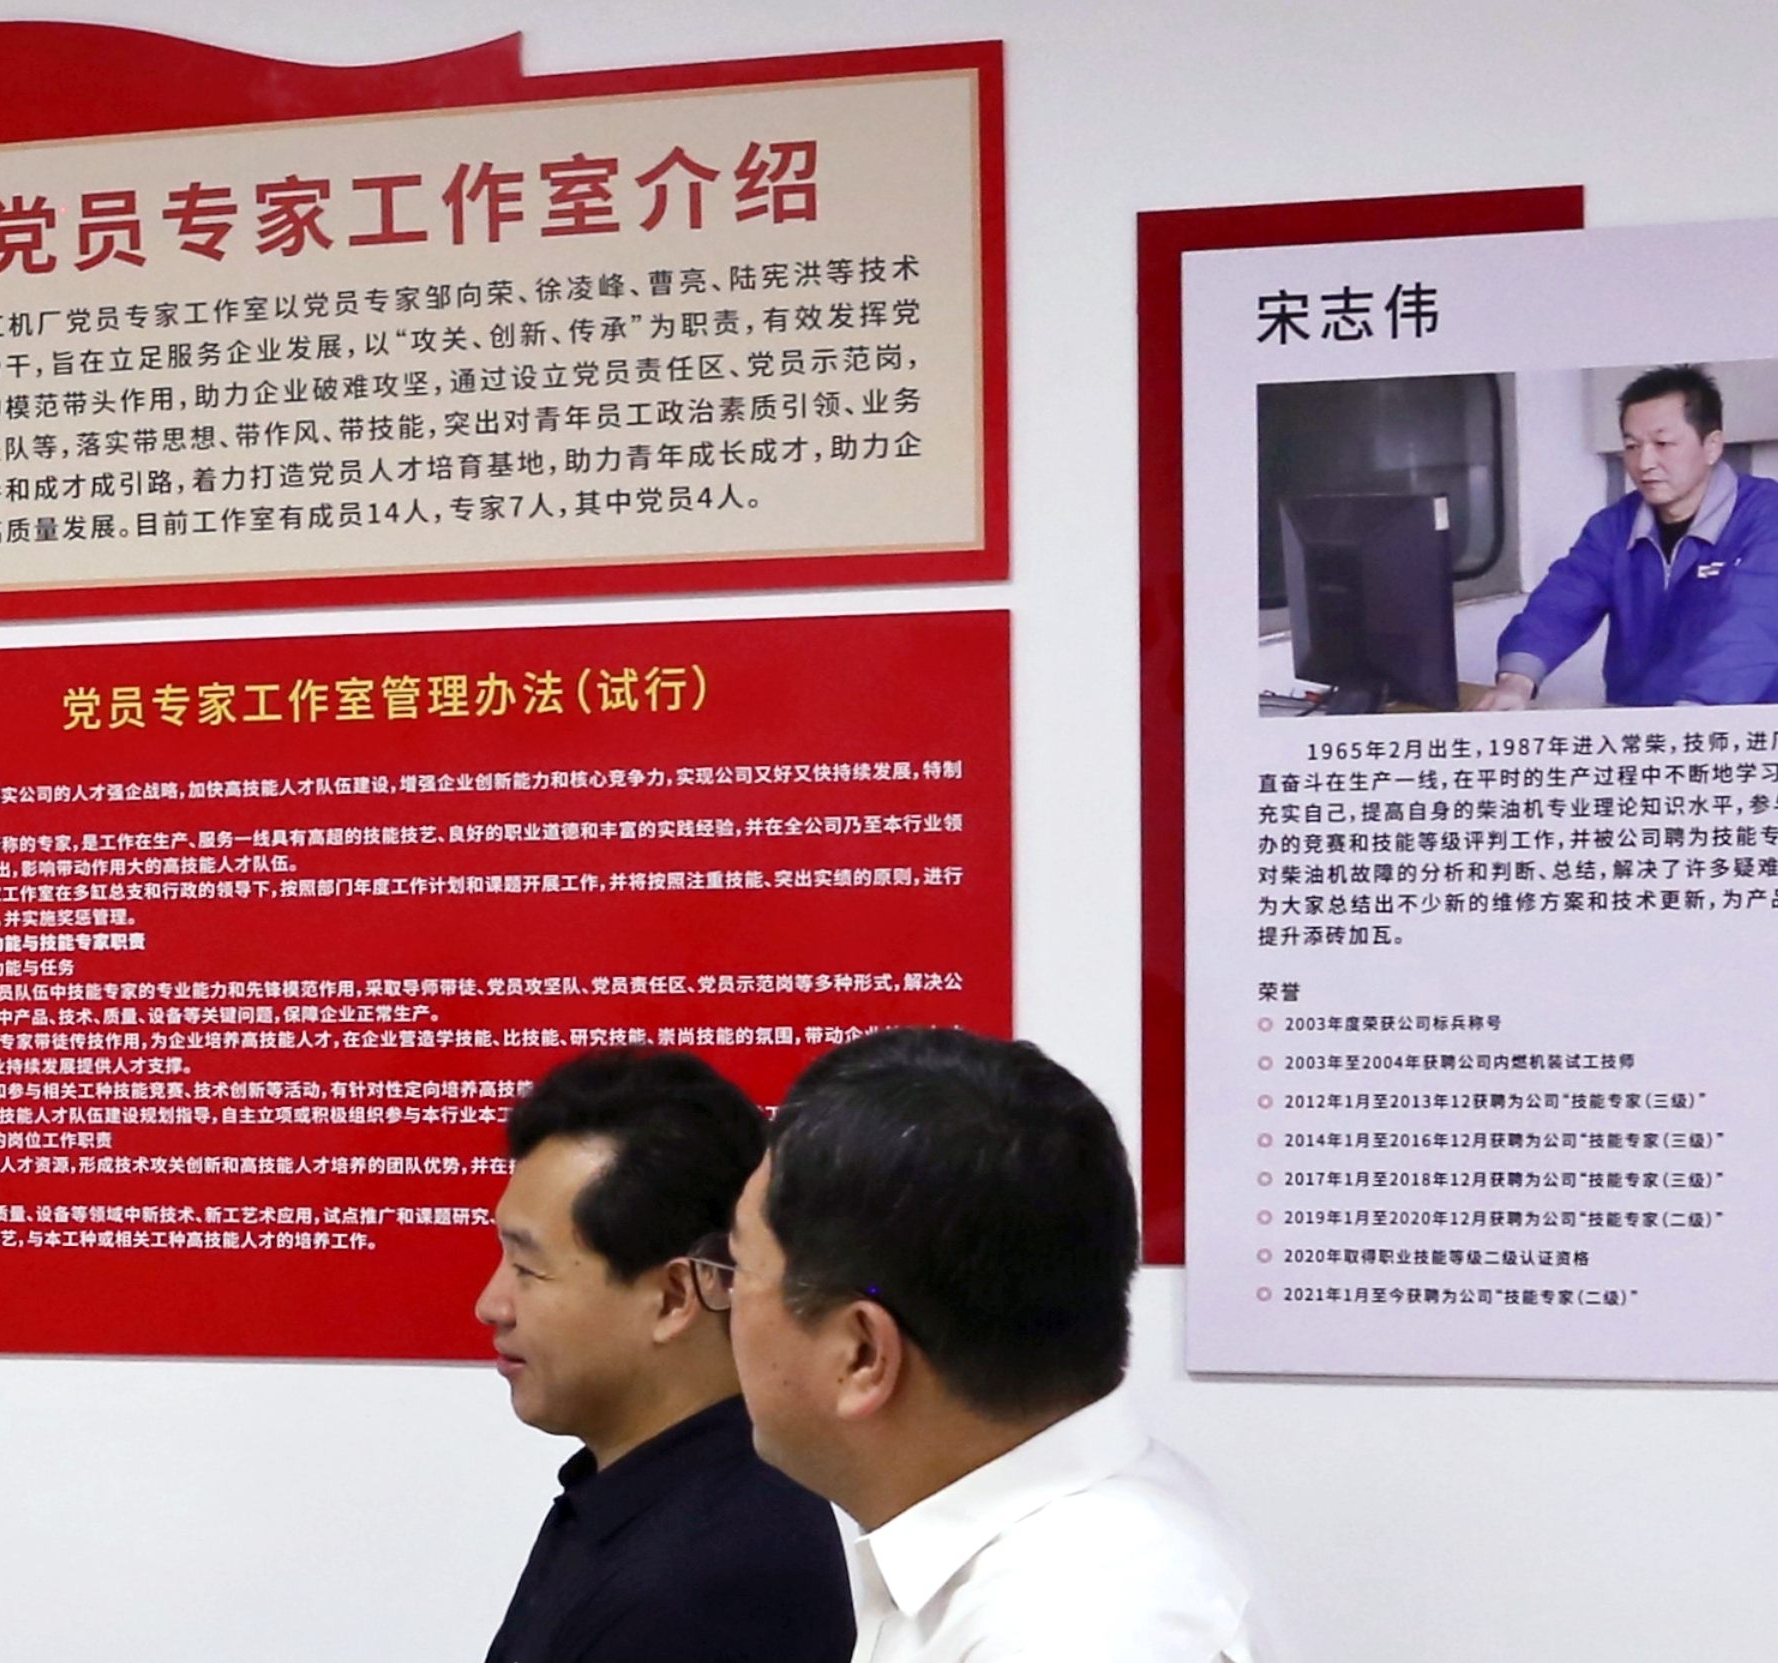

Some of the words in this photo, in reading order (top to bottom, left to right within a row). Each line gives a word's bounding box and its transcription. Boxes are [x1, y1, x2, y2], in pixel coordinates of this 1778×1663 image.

[1256, 281, 1439, 346] 宋志伟
[1258, 794, 1778, 824] 充实自己,提高自身的柴油机专业理论知识水平,参
[1258, 925, 1402, 946] 提升添砖加瓦。
[1258, 982, 1300, 1001] 荣誉
[1285, 1015, 1501, 1031] 2003年度荣获公司标兵称号
[1285, 1054, 1634, 1070] 2003年至2004年获聘公司内燃机装试工技师
[1284, 1249, 1589, 1266] 2020年取得职业技能等级二级认证资格
